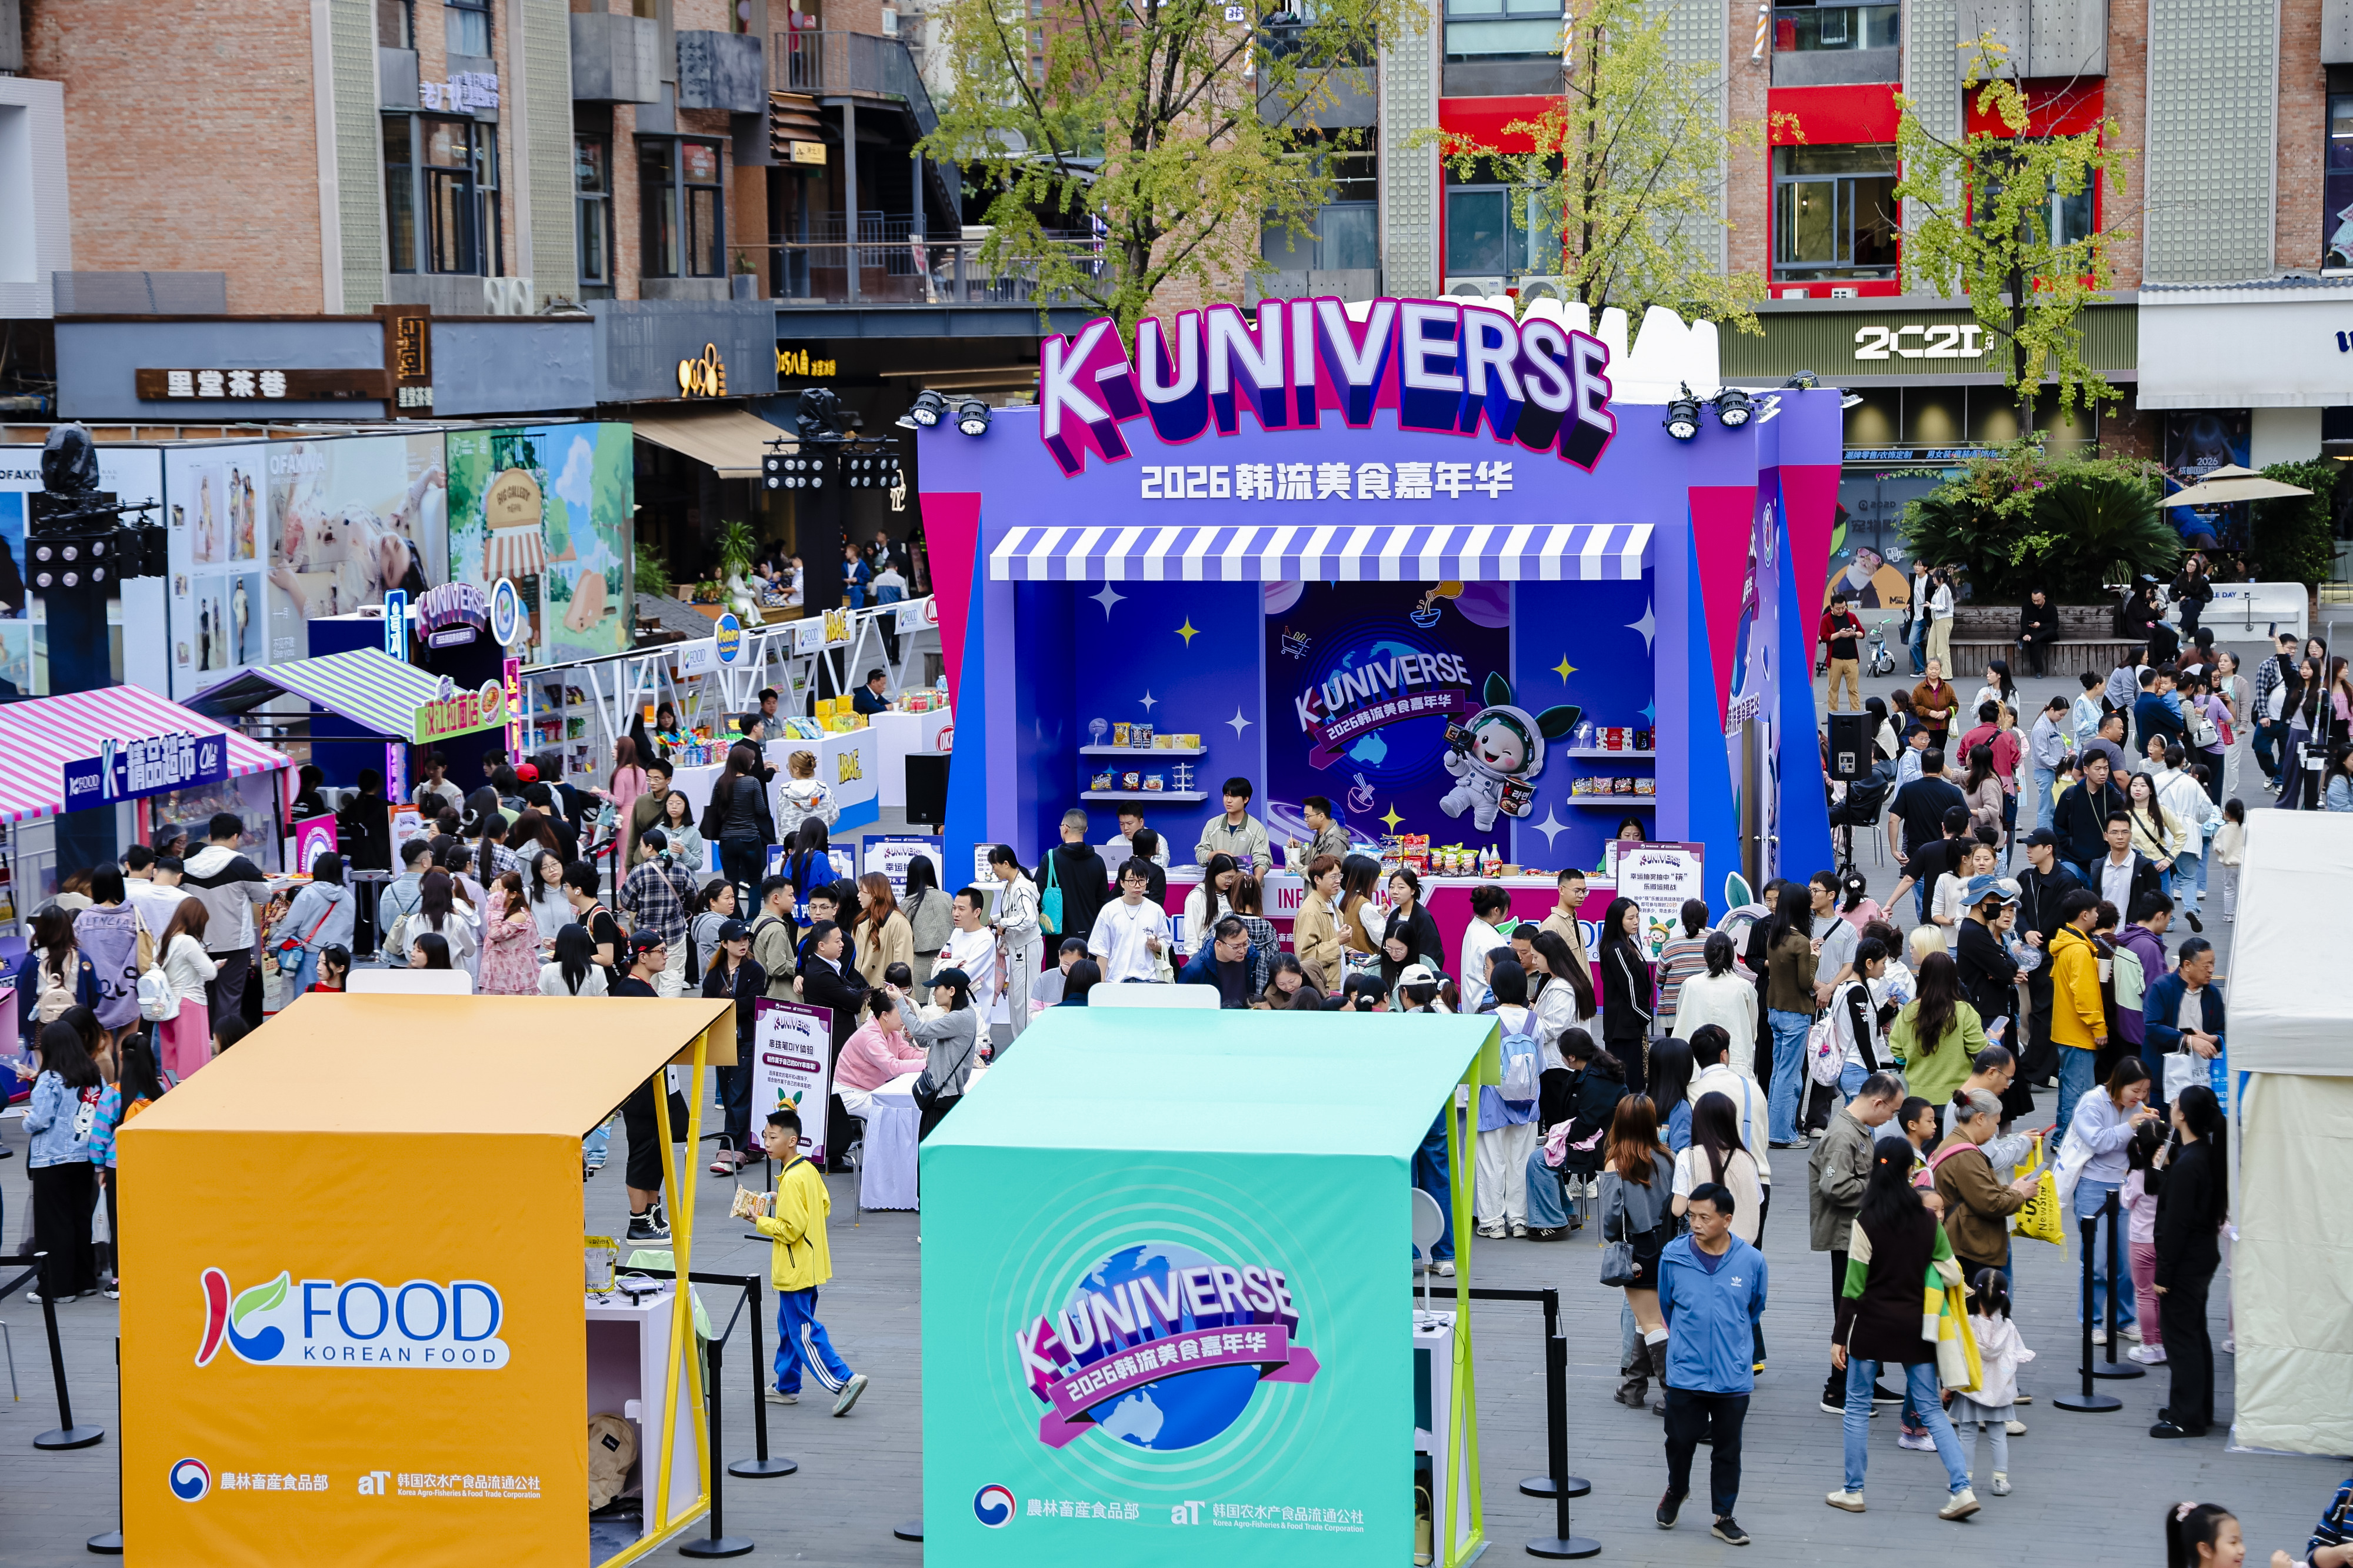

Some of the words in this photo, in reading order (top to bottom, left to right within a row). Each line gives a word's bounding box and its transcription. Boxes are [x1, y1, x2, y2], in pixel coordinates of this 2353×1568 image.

[168, 370, 286, 398] 里堂茶巷
[1041, 299, 1615, 462] K-UNIVERSE
[2197, 457, 2219, 466] 2026
[1141, 462, 1514, 502] 2026韩流美食嘉年华
[415, 582, 487, 642] K-UNIVERSE
[273, 649, 284, 659] See
[284, 648, 294, 659] you
[689, 649, 705, 663] FOOD
[1295, 653, 1472, 732] K-UNIVERSE
[1326, 694, 1452, 741] 2026韩流美食嘉年华
[79, 775, 100, 789] FOOD
[1639, 853, 1681, 868] K-UNIVERSE
[774, 1016, 811, 1037] K-UNIVERSE
[768, 1039, 814, 1056] 串珠笔DIY体验
[304, 1282, 500, 1342] FOOD
[1014, 1263, 1299, 1402] K-UNIVERSE
[304, 1346, 411, 1362] KOREAN
[425, 1347, 496, 1363] FOOD
[1065, 1330, 1268, 1402] 2026韩流美食嘉年华
[220, 1472, 328, 1492] 農林畜産食品部
[358, 1471, 391, 1496] aT
[398, 1472, 541, 1490] 韩国农水产食品流通公社
[398, 1488, 416, 1496] Korea
[418, 1489, 462, 1498] Agro-Fisheries
[502, 1490, 541, 1499] Corporation
[1026, 1499, 1140, 1520] 農林畜産食品部
[1171, 1500, 1205, 1525] aT
[1213, 1503, 1365, 1524] 韩国农水产食品流通公社
[1213, 1519, 1232, 1527] Korea
[1234, 1520, 1279, 1529] Agro-Fisheries
[1287, 1522, 1304, 1530] Food
[1305, 1523, 1323, 1531] Trade
[1324, 1524, 1365, 1534] Corporation
